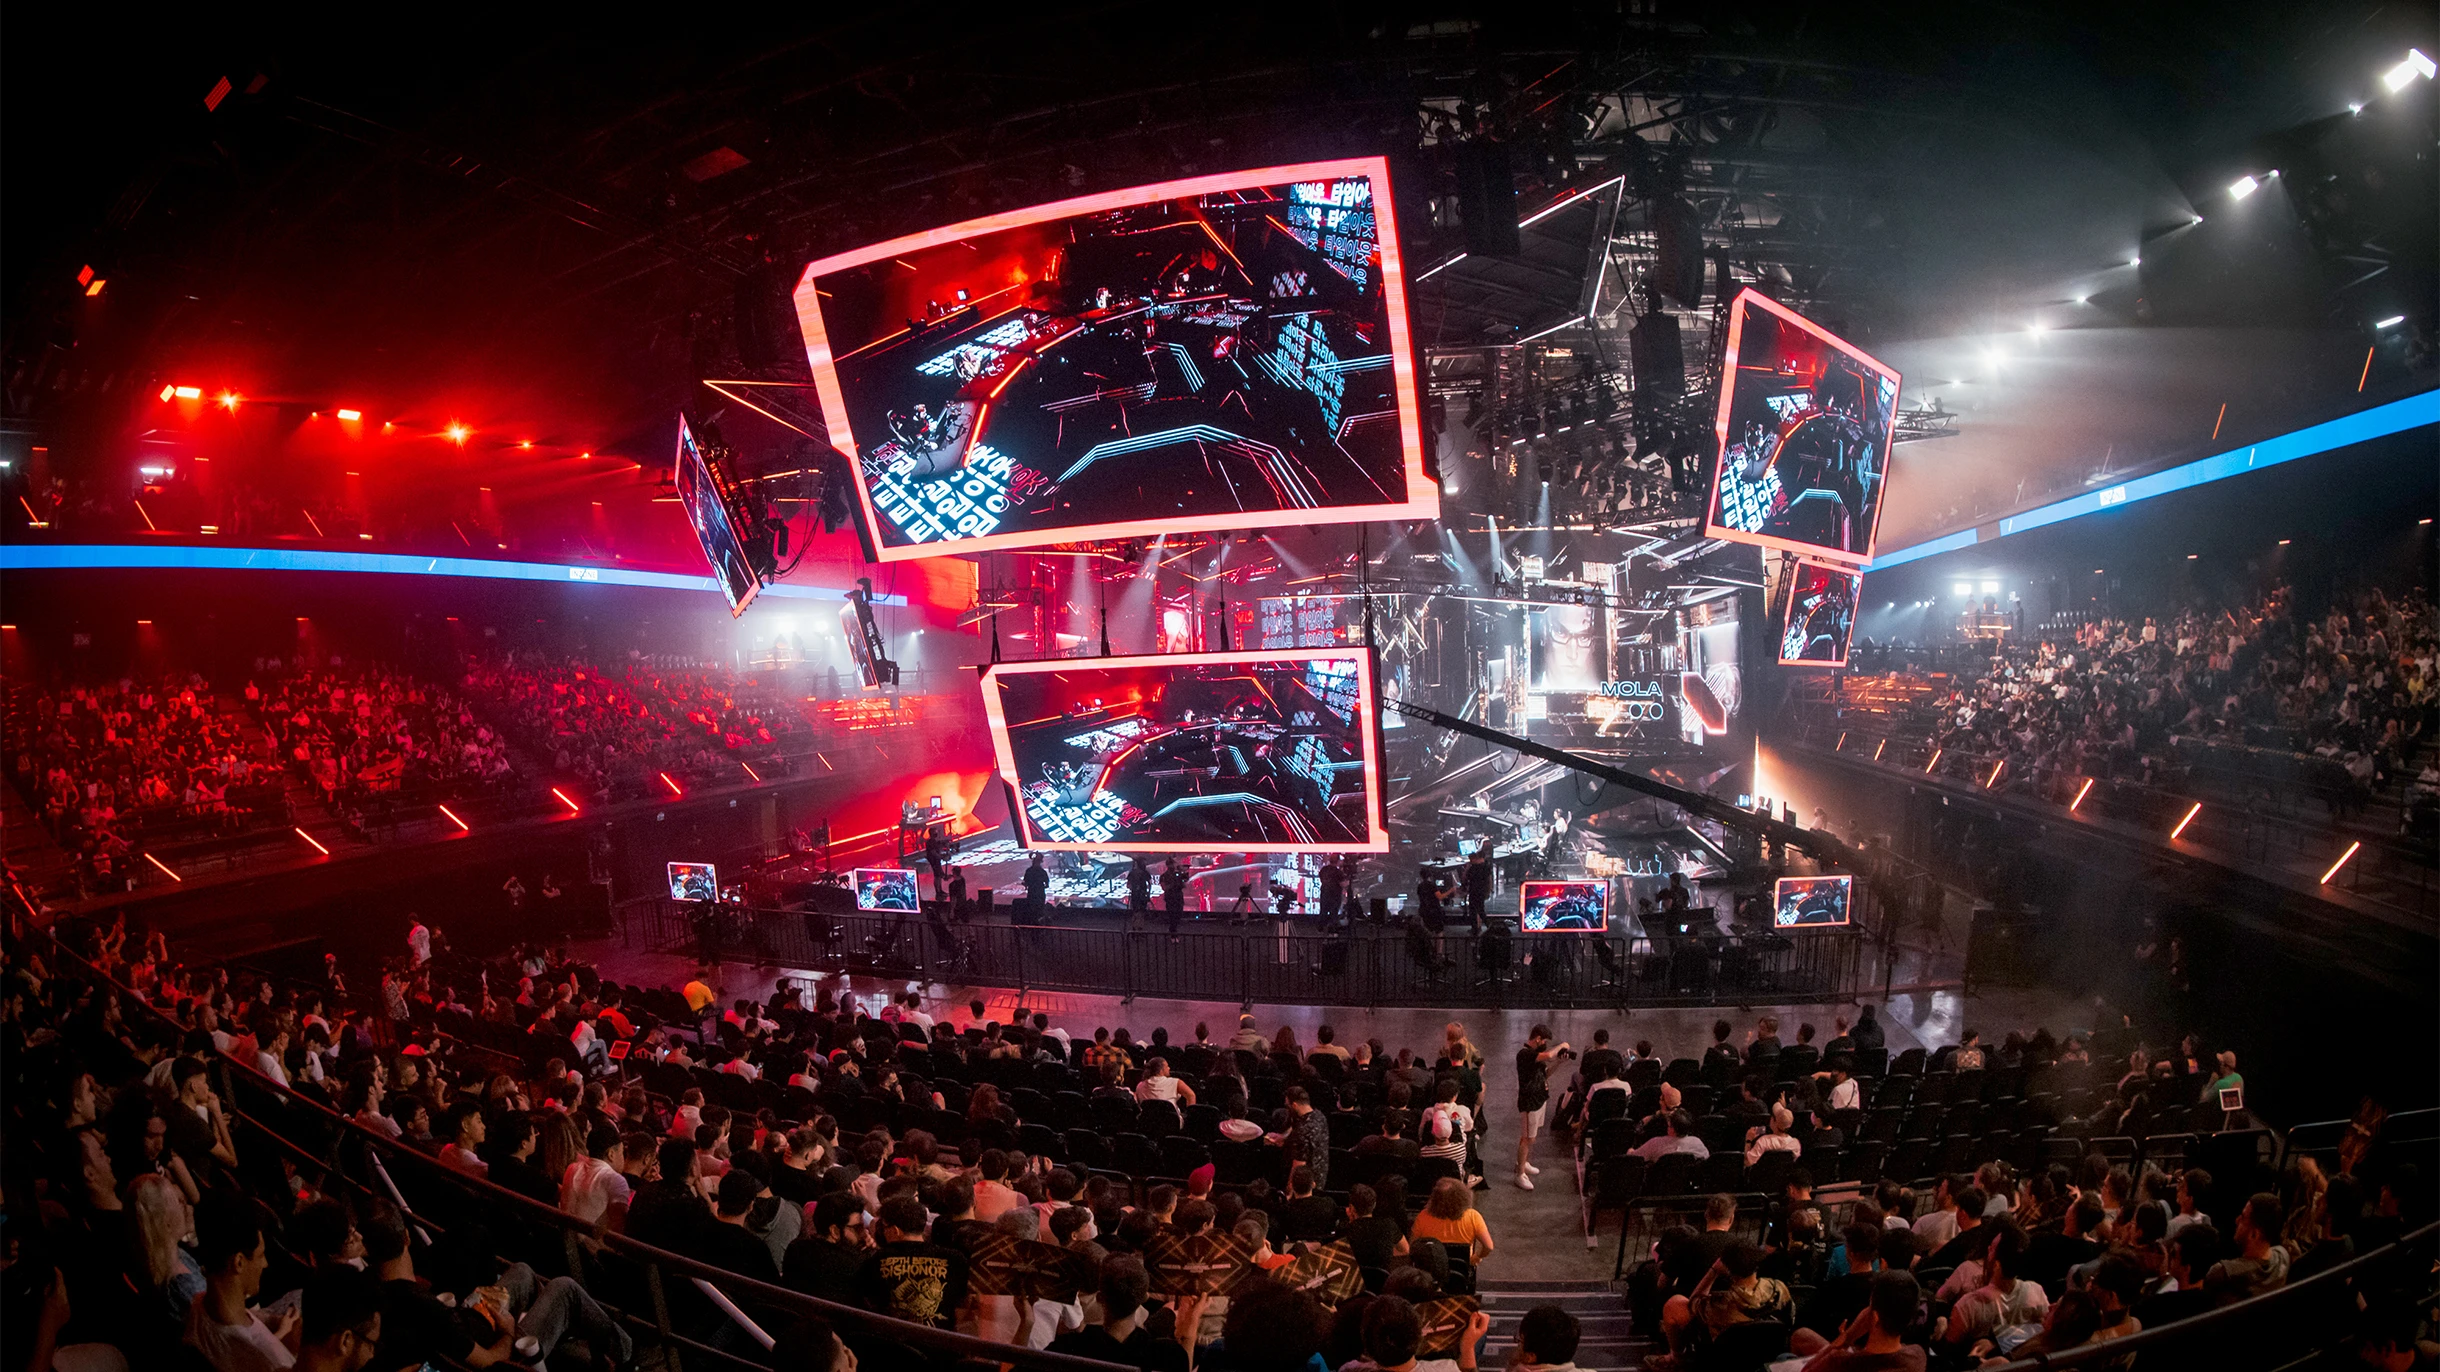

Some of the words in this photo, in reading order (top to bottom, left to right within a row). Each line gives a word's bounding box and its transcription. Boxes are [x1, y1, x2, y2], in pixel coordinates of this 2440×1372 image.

[1330, 181, 1373, 208] 타임아
[1600, 681, 1663, 697] MOLA
[880, 1265, 948, 1279] DISHONOR
